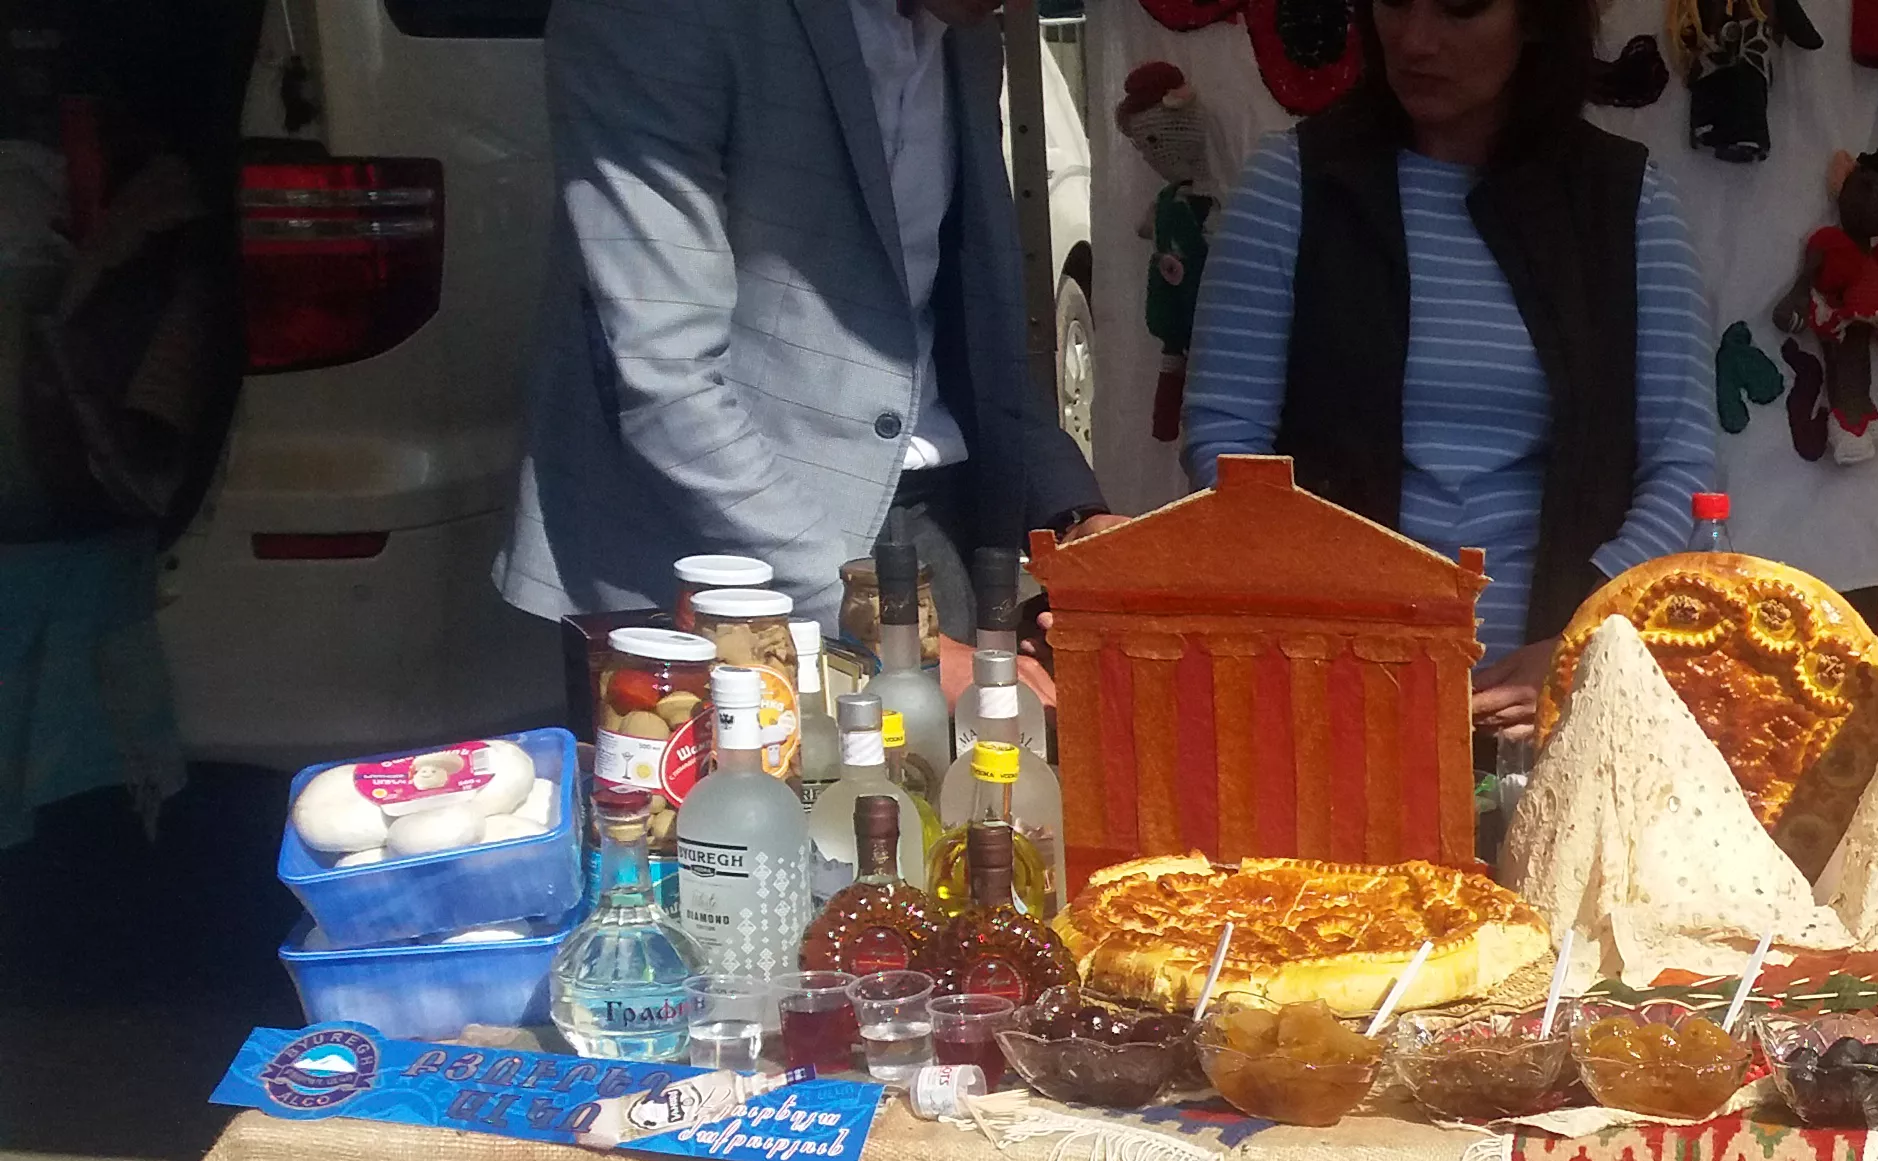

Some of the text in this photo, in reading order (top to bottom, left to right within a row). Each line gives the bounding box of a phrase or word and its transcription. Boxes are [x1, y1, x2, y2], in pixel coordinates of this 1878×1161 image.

[686, 909, 730, 925] DIAMOND
[285, 1031, 376, 1066] BYUREGH
[276, 1091, 331, 1107] ALCO
